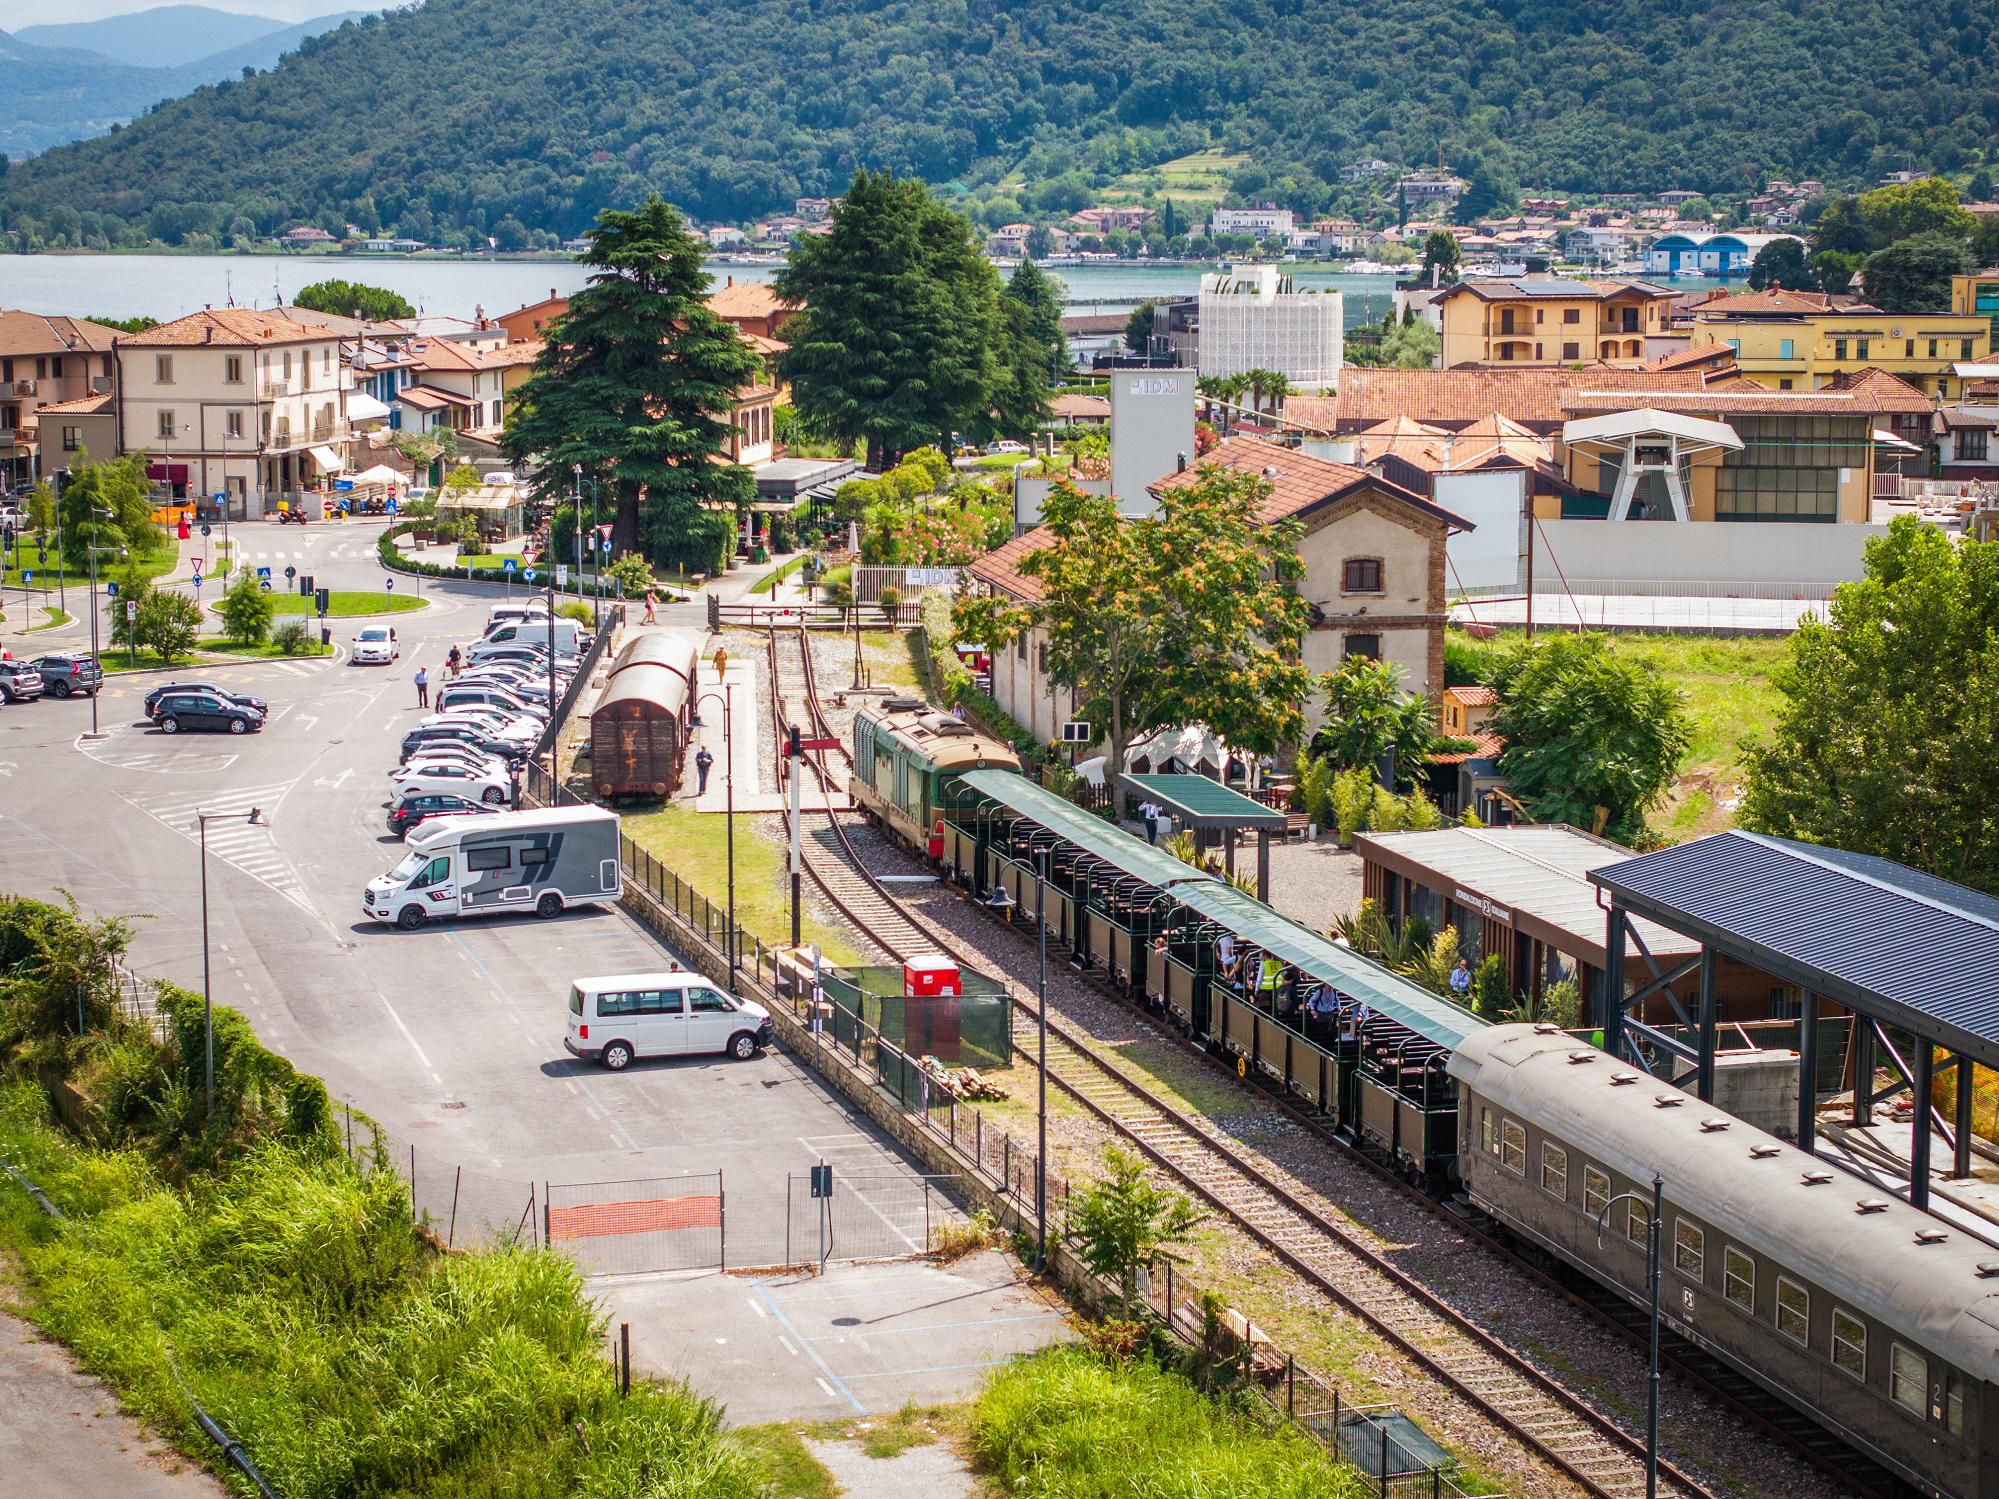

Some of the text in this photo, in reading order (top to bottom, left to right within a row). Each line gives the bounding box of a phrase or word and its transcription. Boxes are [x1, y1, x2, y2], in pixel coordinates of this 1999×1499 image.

[1144, 378, 1179, 393] IDM
[1493, 1126, 1499, 1141] 2
[1933, 1383, 1940, 1402] 2
